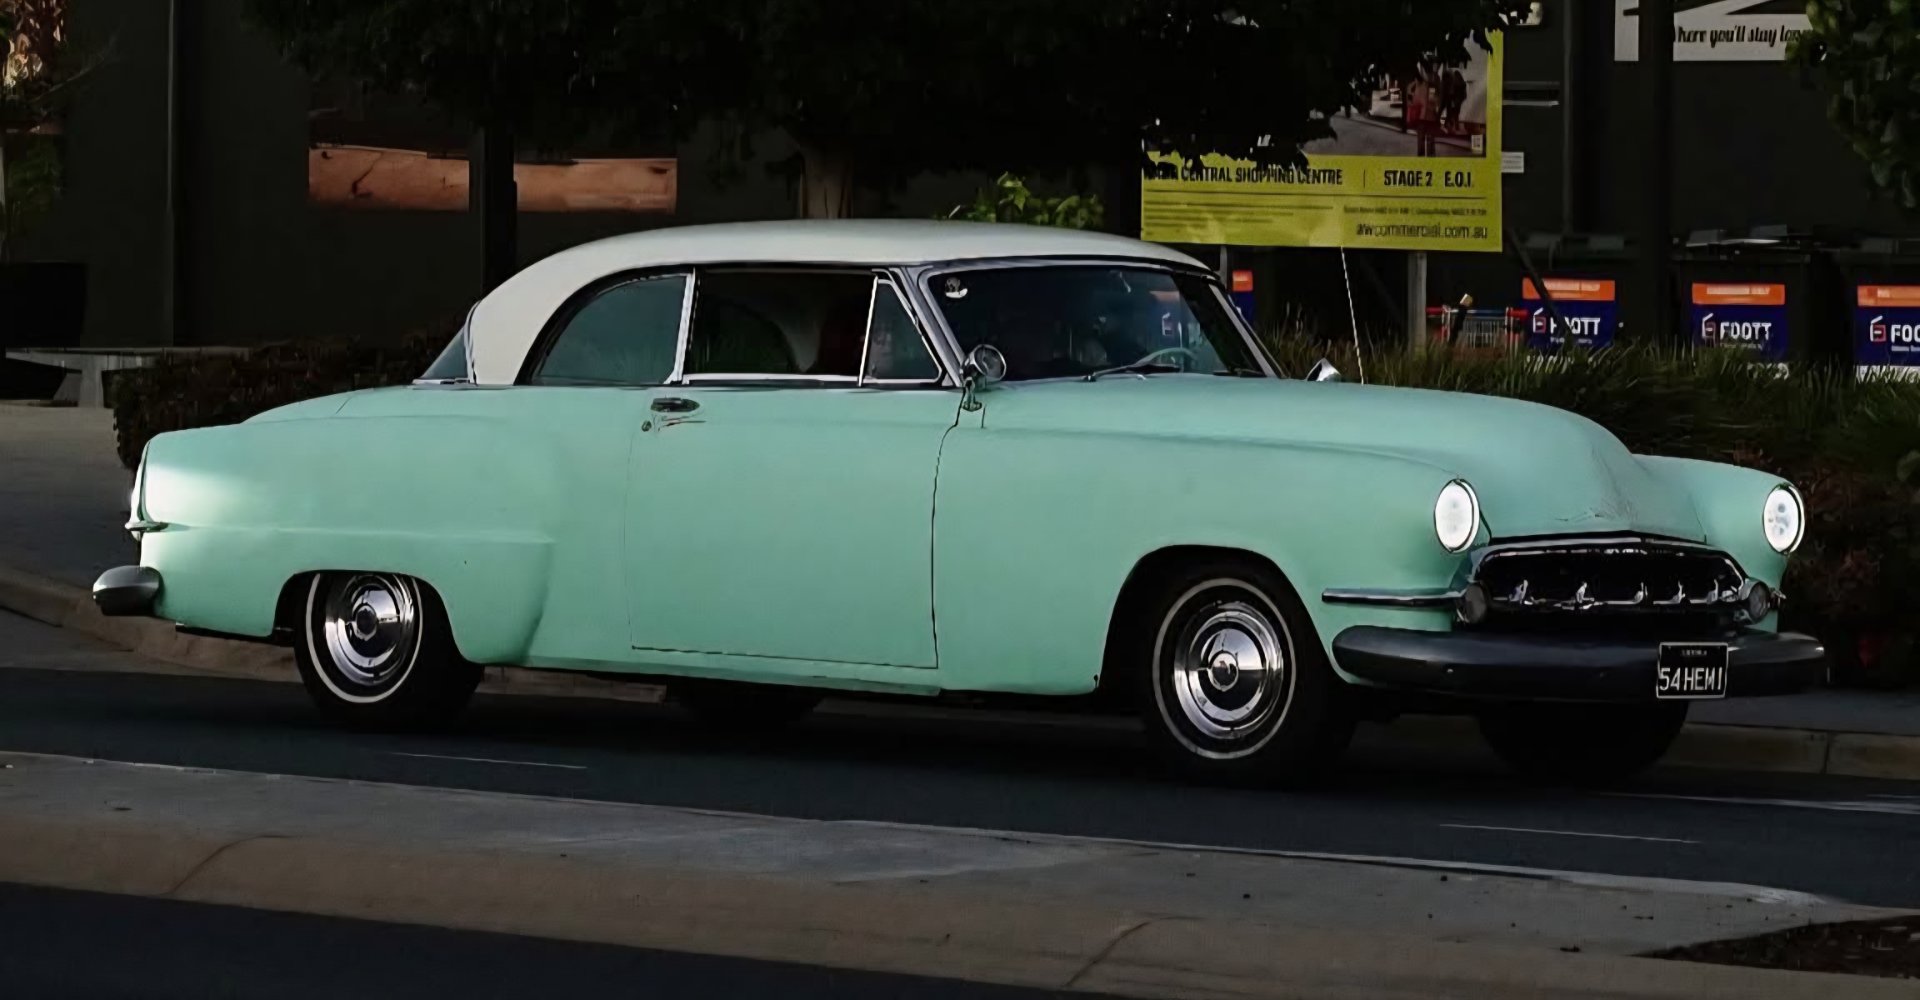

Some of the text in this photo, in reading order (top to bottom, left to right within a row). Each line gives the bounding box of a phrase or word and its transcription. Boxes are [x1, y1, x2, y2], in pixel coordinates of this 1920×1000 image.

[1672, 26, 1705, 43] here
[1710, 25, 1746, 48] you'll
[1748, 26, 1777, 47] stay
[1181, 166, 1232, 183] CENTRAL
[1299, 168, 1343, 185] CENTRE
[1384, 170, 1423, 187] STAGE
[1426, 171, 1433, 187] 2
[1550, 317, 1601, 336] FOTT
[1720, 322, 1772, 340] FOOTT
